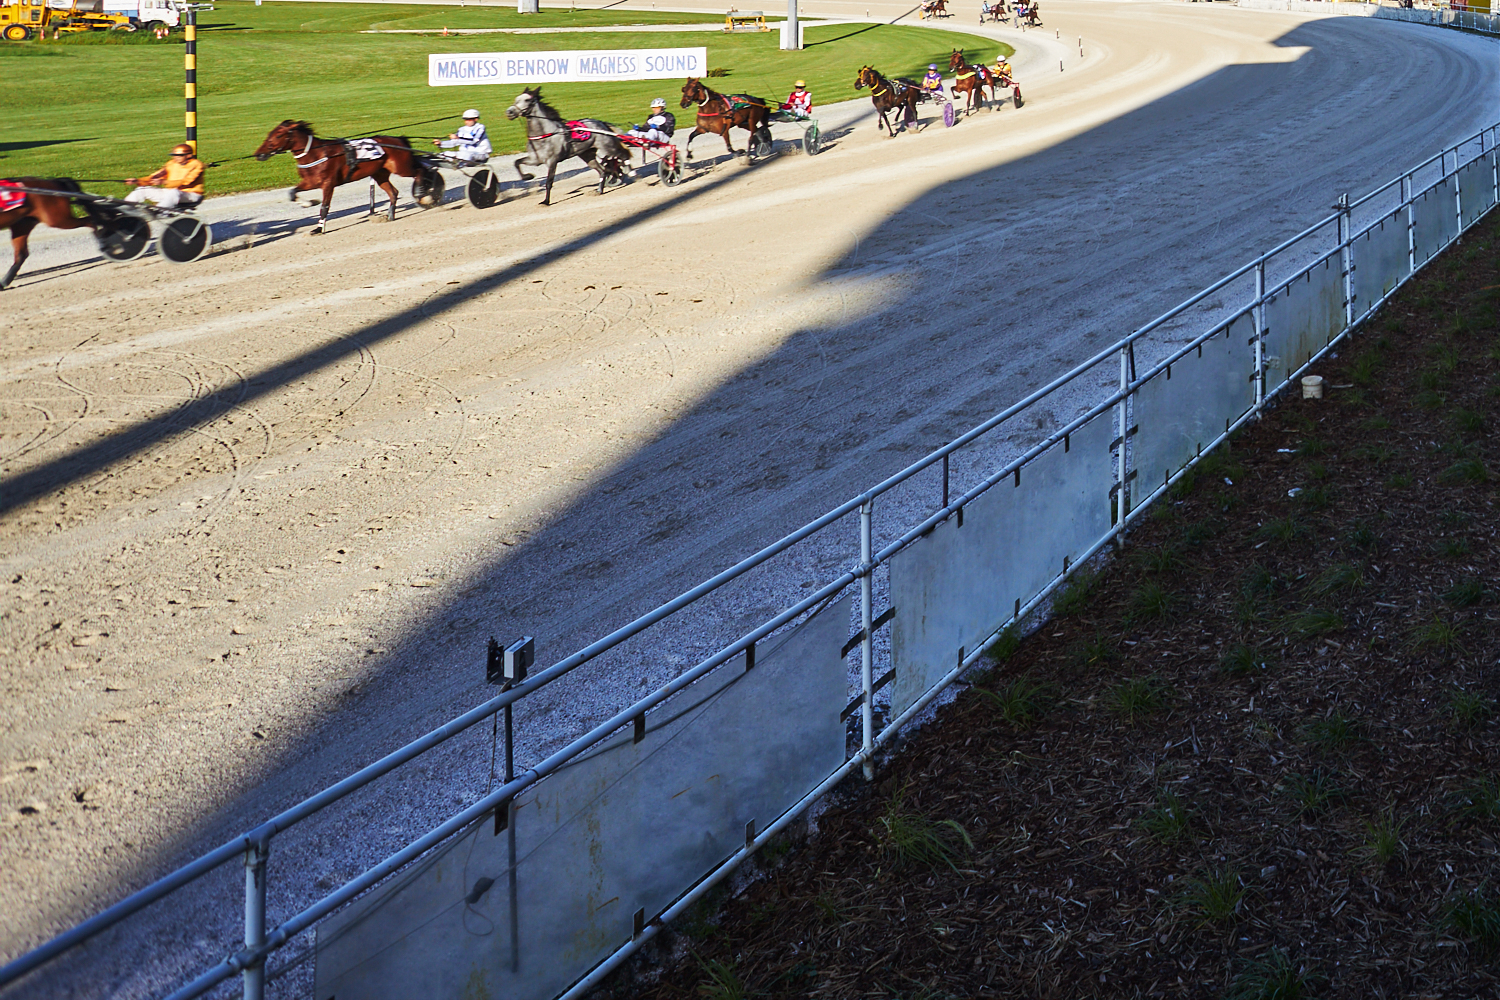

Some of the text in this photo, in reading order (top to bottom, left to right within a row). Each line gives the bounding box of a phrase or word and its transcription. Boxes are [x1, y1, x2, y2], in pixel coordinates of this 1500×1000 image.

[438, 55, 698, 79] MAGNESS BENROW MAGNESS SOUND
